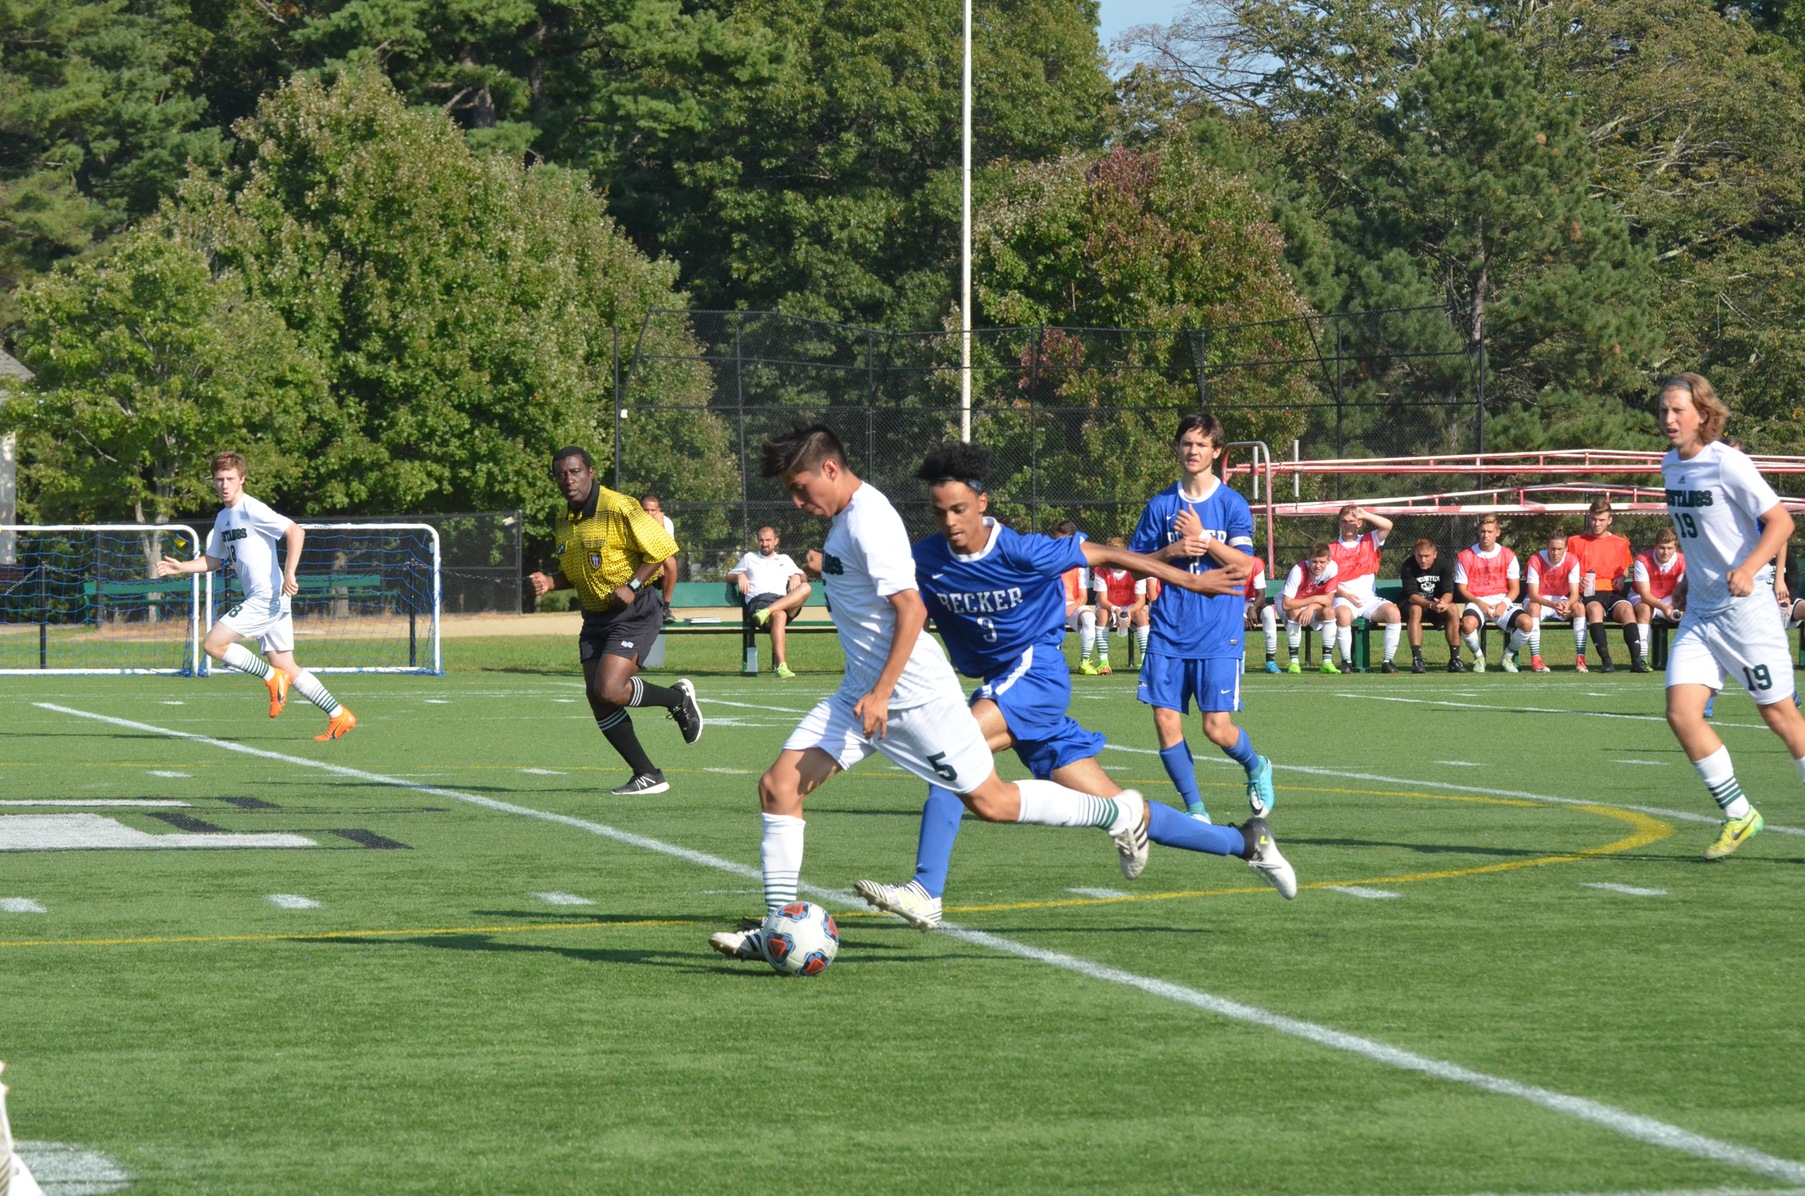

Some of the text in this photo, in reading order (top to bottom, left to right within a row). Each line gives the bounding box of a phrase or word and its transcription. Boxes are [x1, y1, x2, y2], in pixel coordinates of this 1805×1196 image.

[1675, 513, 1698, 538] 19
[937, 587, 1023, 614] BECKER
[977, 616, 998, 643] 9
[1743, 664, 1773, 691] 19
[926, 751, 958, 781] 5
